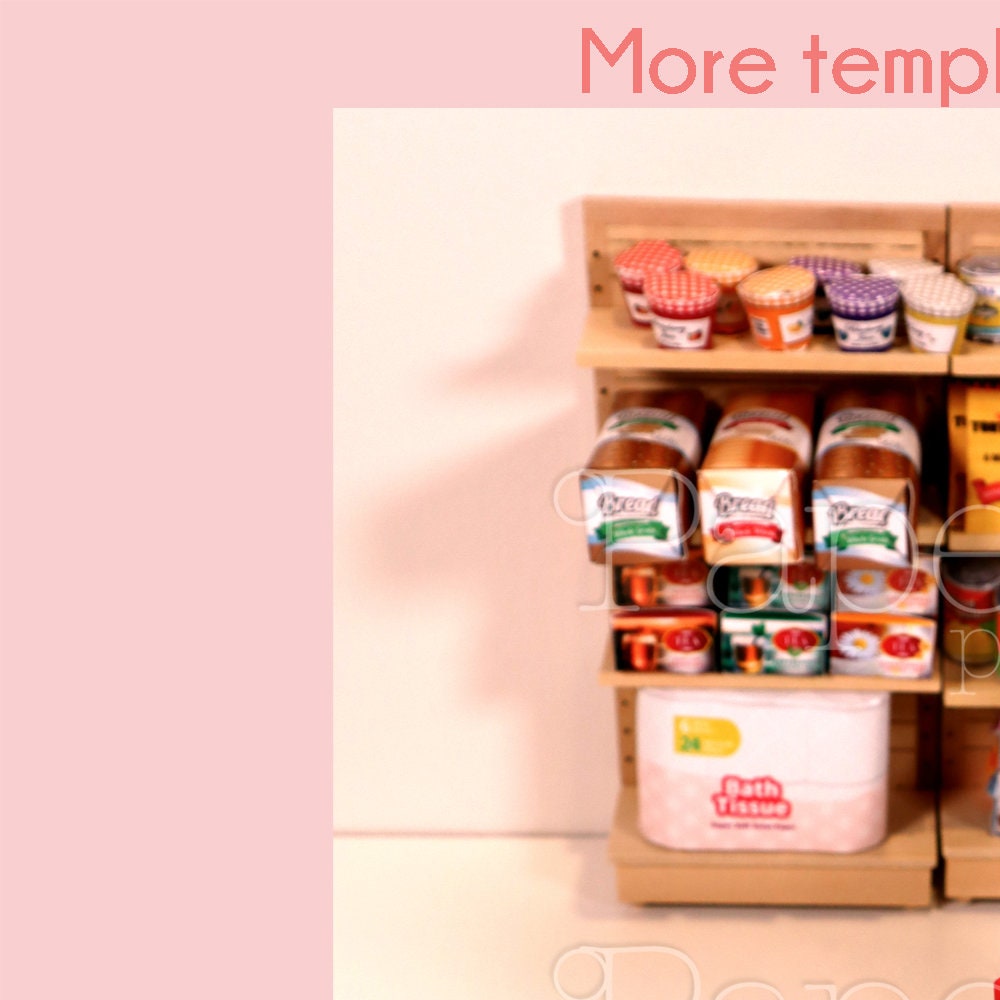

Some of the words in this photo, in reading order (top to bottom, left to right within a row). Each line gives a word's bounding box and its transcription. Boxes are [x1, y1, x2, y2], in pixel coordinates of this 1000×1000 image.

[598, 491, 661, 517] Bread
[714, 492, 776, 519] Bread
[827, 500, 892, 526] Bread
[722, 774, 783, 799] Bath
[711, 793, 792, 819] Tissue
